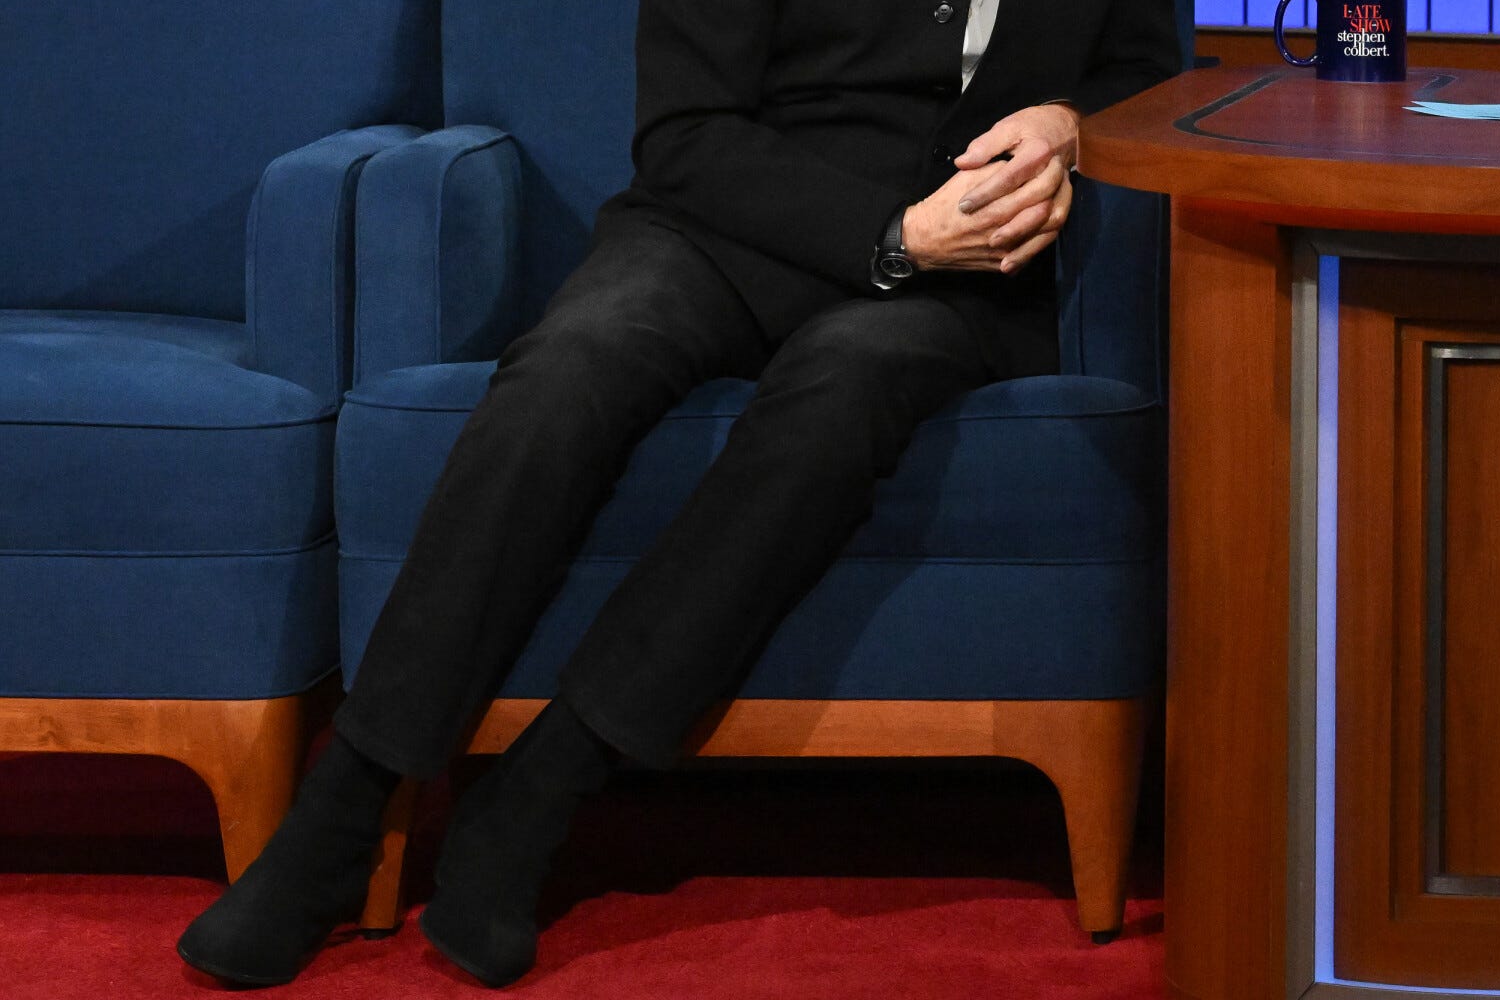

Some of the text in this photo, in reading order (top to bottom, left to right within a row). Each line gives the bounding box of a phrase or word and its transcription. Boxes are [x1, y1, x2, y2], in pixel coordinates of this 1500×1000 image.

[1343, 4, 1381, 19] LATE
[1350, 18, 1392, 33] SHOW
[1337, 28, 1385, 48] stephen
[1343, 42, 1390, 57] colbert.
